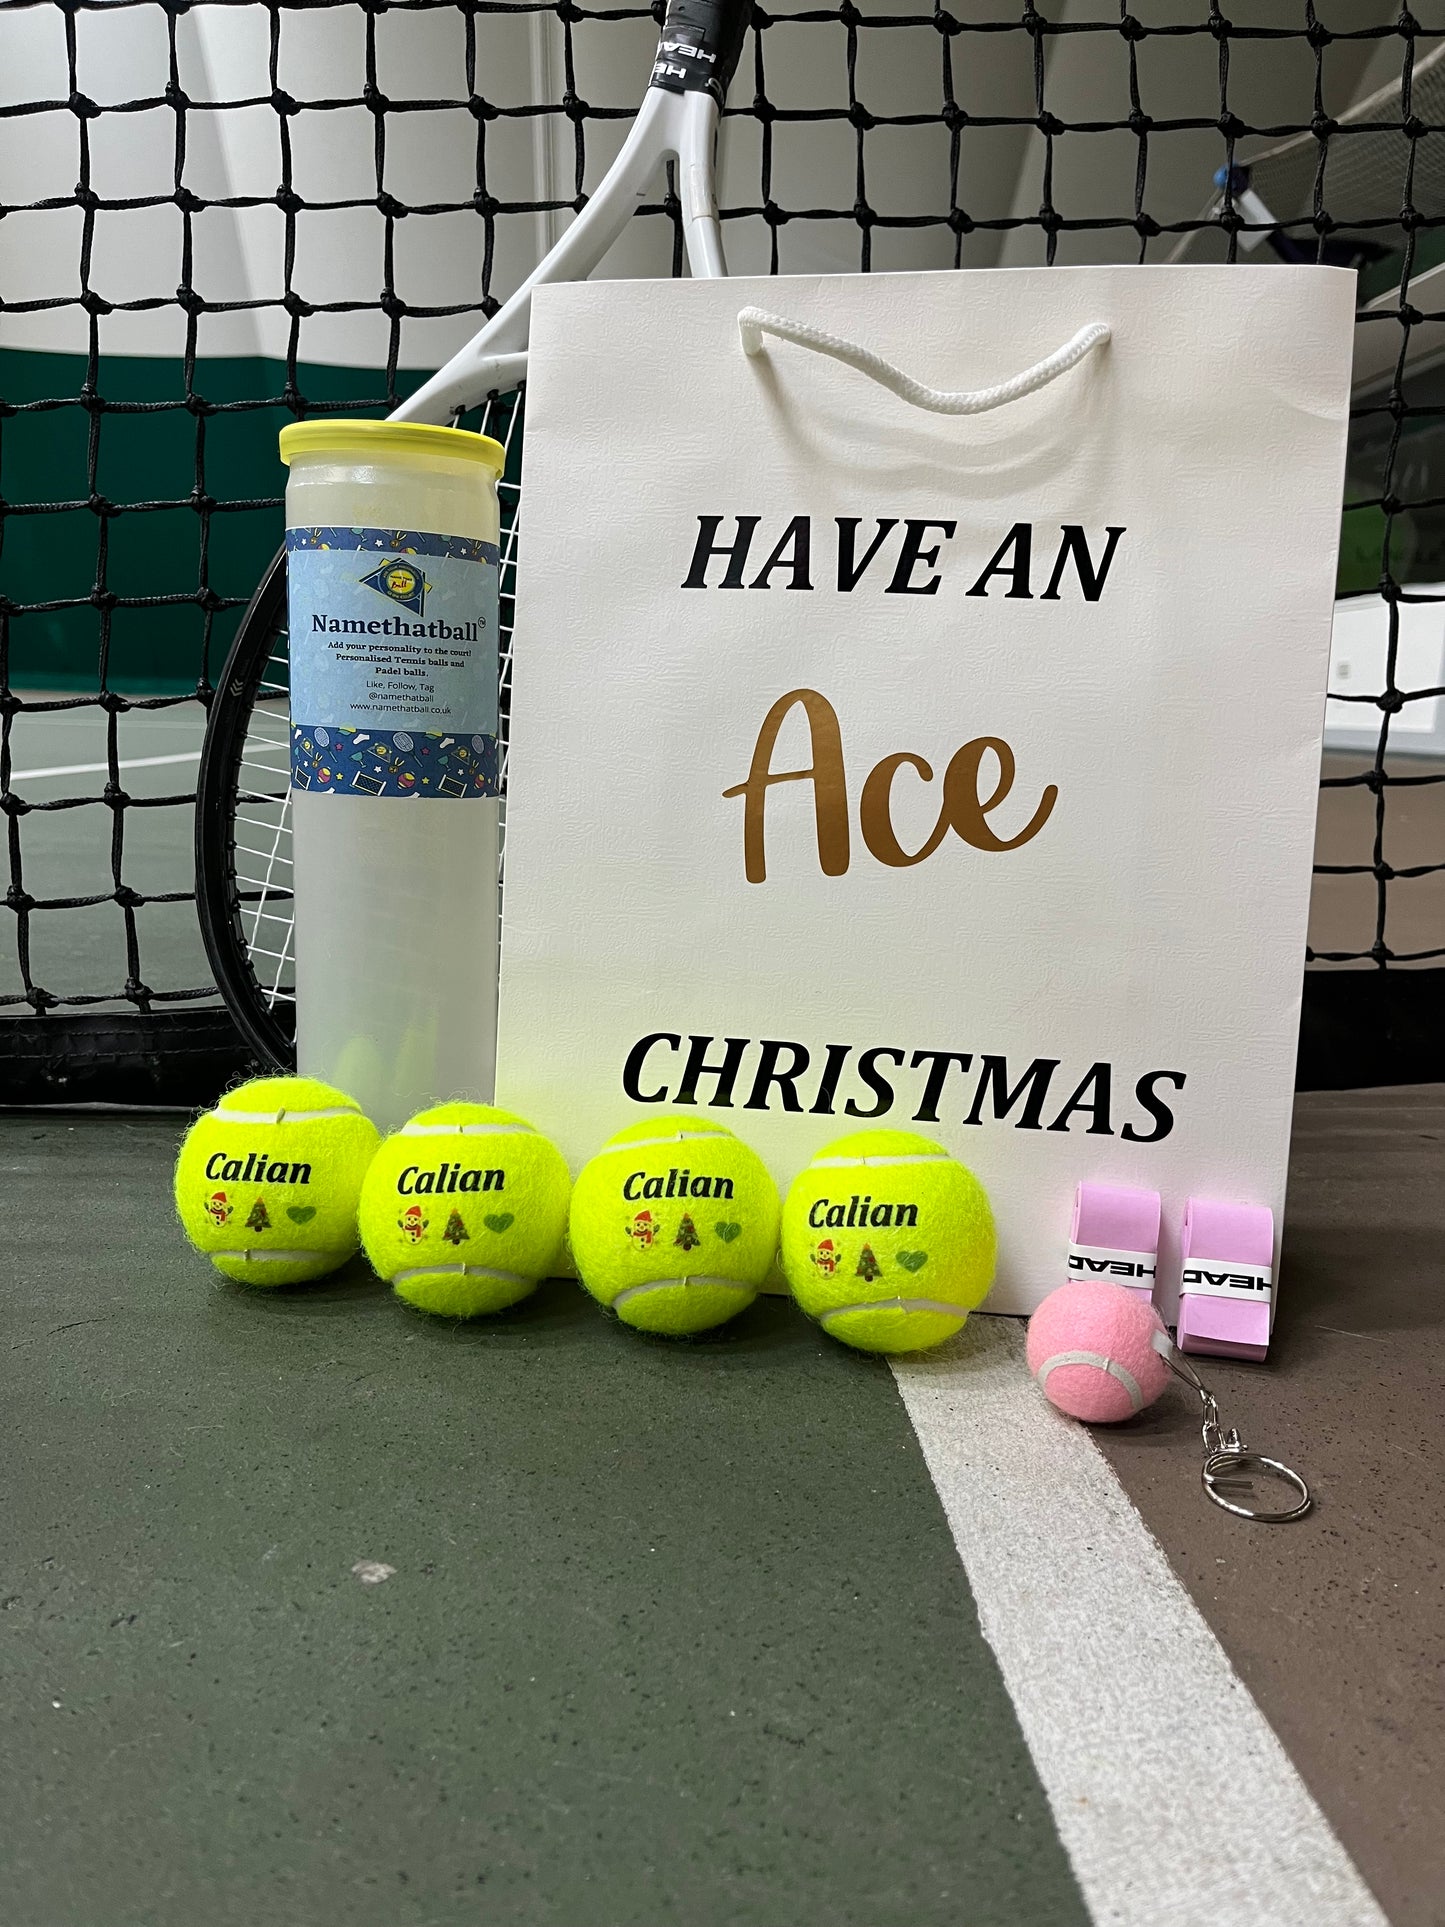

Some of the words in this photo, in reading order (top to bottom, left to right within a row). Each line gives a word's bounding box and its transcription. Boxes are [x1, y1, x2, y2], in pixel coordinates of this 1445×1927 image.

[662, 41, 717, 63] HEA
[654, 62, 687, 79] HE
[680, 515, 958, 595] HAVE
[965, 522, 1128, 602] AN
[311, 614, 478, 641] Namethatball
[328, 641, 344, 649] Add
[346, 643, 367, 651] your
[369, 644, 421, 655] personality
[435, 647, 449, 655] the
[450, 649, 472, 657] court!
[336, 653, 392, 663] Personalised
[394, 656, 426, 665] Tennis
[428, 658, 449, 667] balls
[450, 660, 465, 668] and
[375, 667, 401, 675] Padel
[403, 668, 429, 677] balls.
[366, 680, 386, 690] Like,
[387, 681, 418, 691] Follow,
[419, 683, 435, 693] Tag
[368, 692, 434, 702] @namethatball
[349, 703, 452, 715] www.namethatball.co.uk
[721, 687, 1059, 884] Ace
[621, 1031, 1188, 1144] CHRISTMAS
[205, 1152, 312, 1185] Calian
[397, 1163, 506, 1196] Calian
[623, 1167, 735, 1201] Calian
[808, 1194, 919, 1229] Calian
